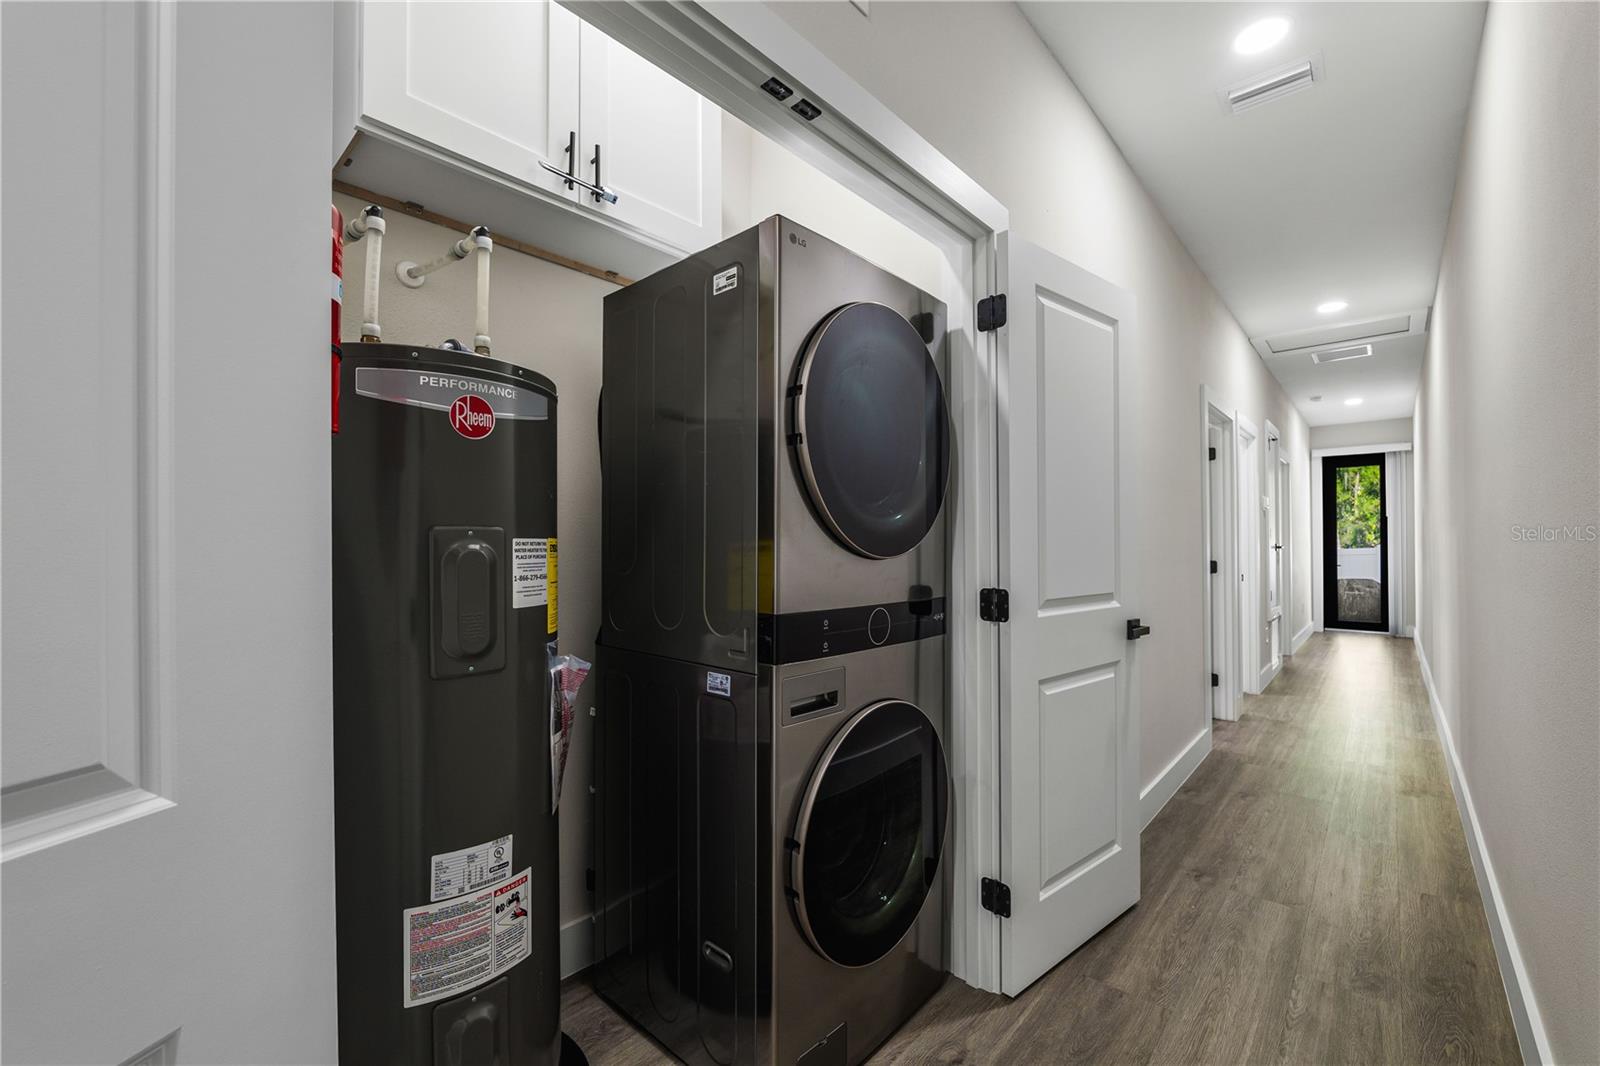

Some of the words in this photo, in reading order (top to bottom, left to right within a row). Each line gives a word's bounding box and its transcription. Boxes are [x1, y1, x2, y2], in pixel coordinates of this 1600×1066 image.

[798, 236, 807, 248] LG
[420, 375, 518, 399] PERFORMANCE
[455, 395, 492, 432] Rheem
[502, 876, 526, 892] DANGER
